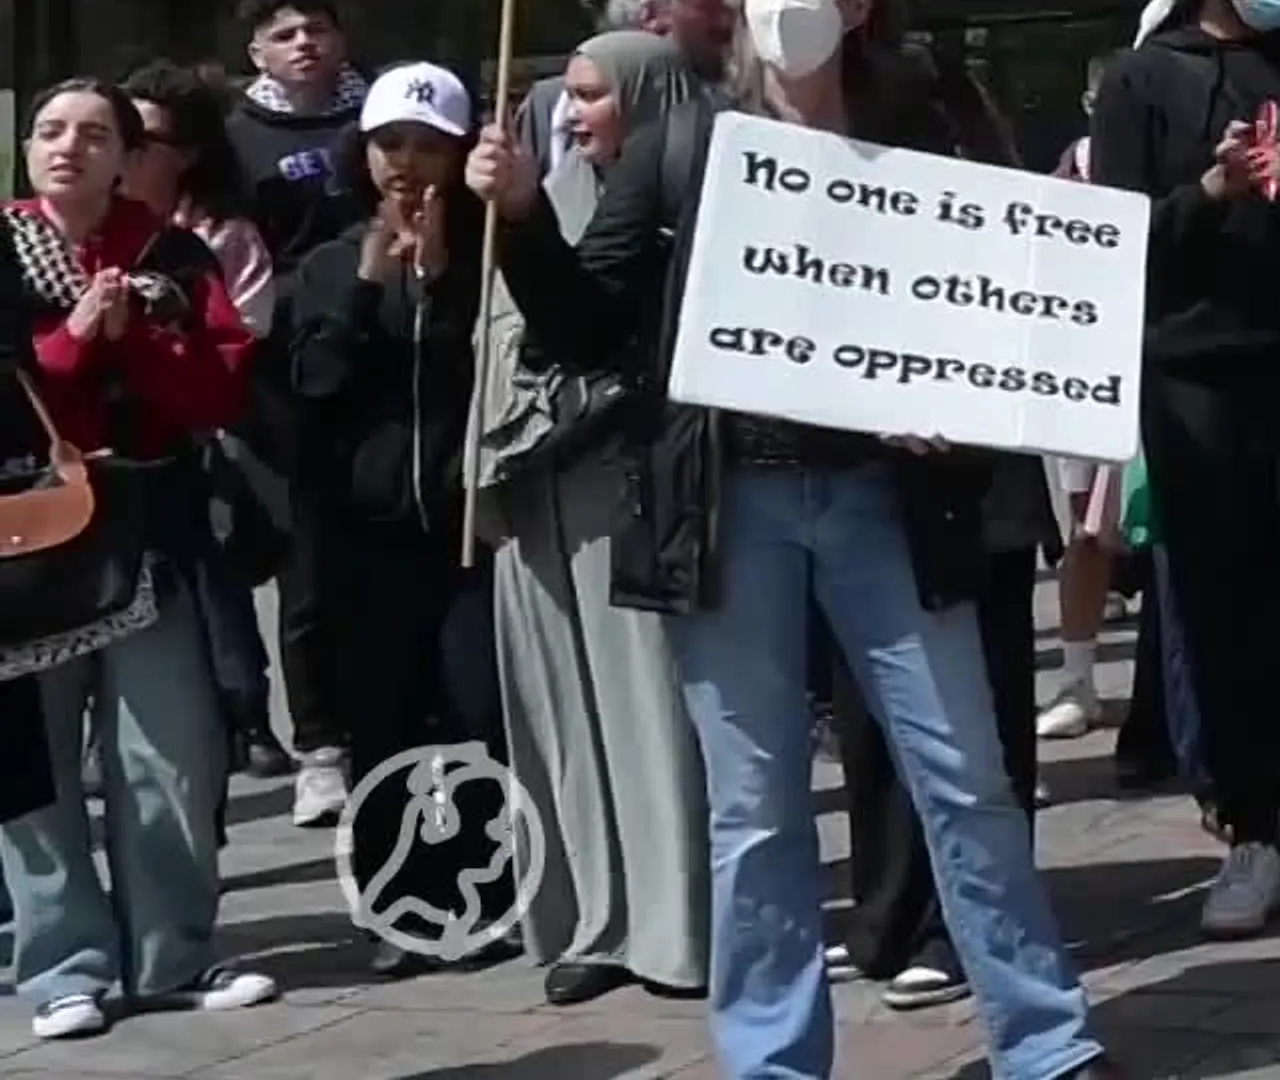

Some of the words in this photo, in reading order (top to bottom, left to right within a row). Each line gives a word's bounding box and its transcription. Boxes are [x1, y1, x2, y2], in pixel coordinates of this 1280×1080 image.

[826, 178, 919, 216] one
[937, 191, 985, 229] is
[1003, 202, 1121, 248] free
[743, 244, 890, 295] when
[911, 272, 1098, 326] others
[708, 323, 817, 366] are
[832, 342, 1123, 406] oppressed
